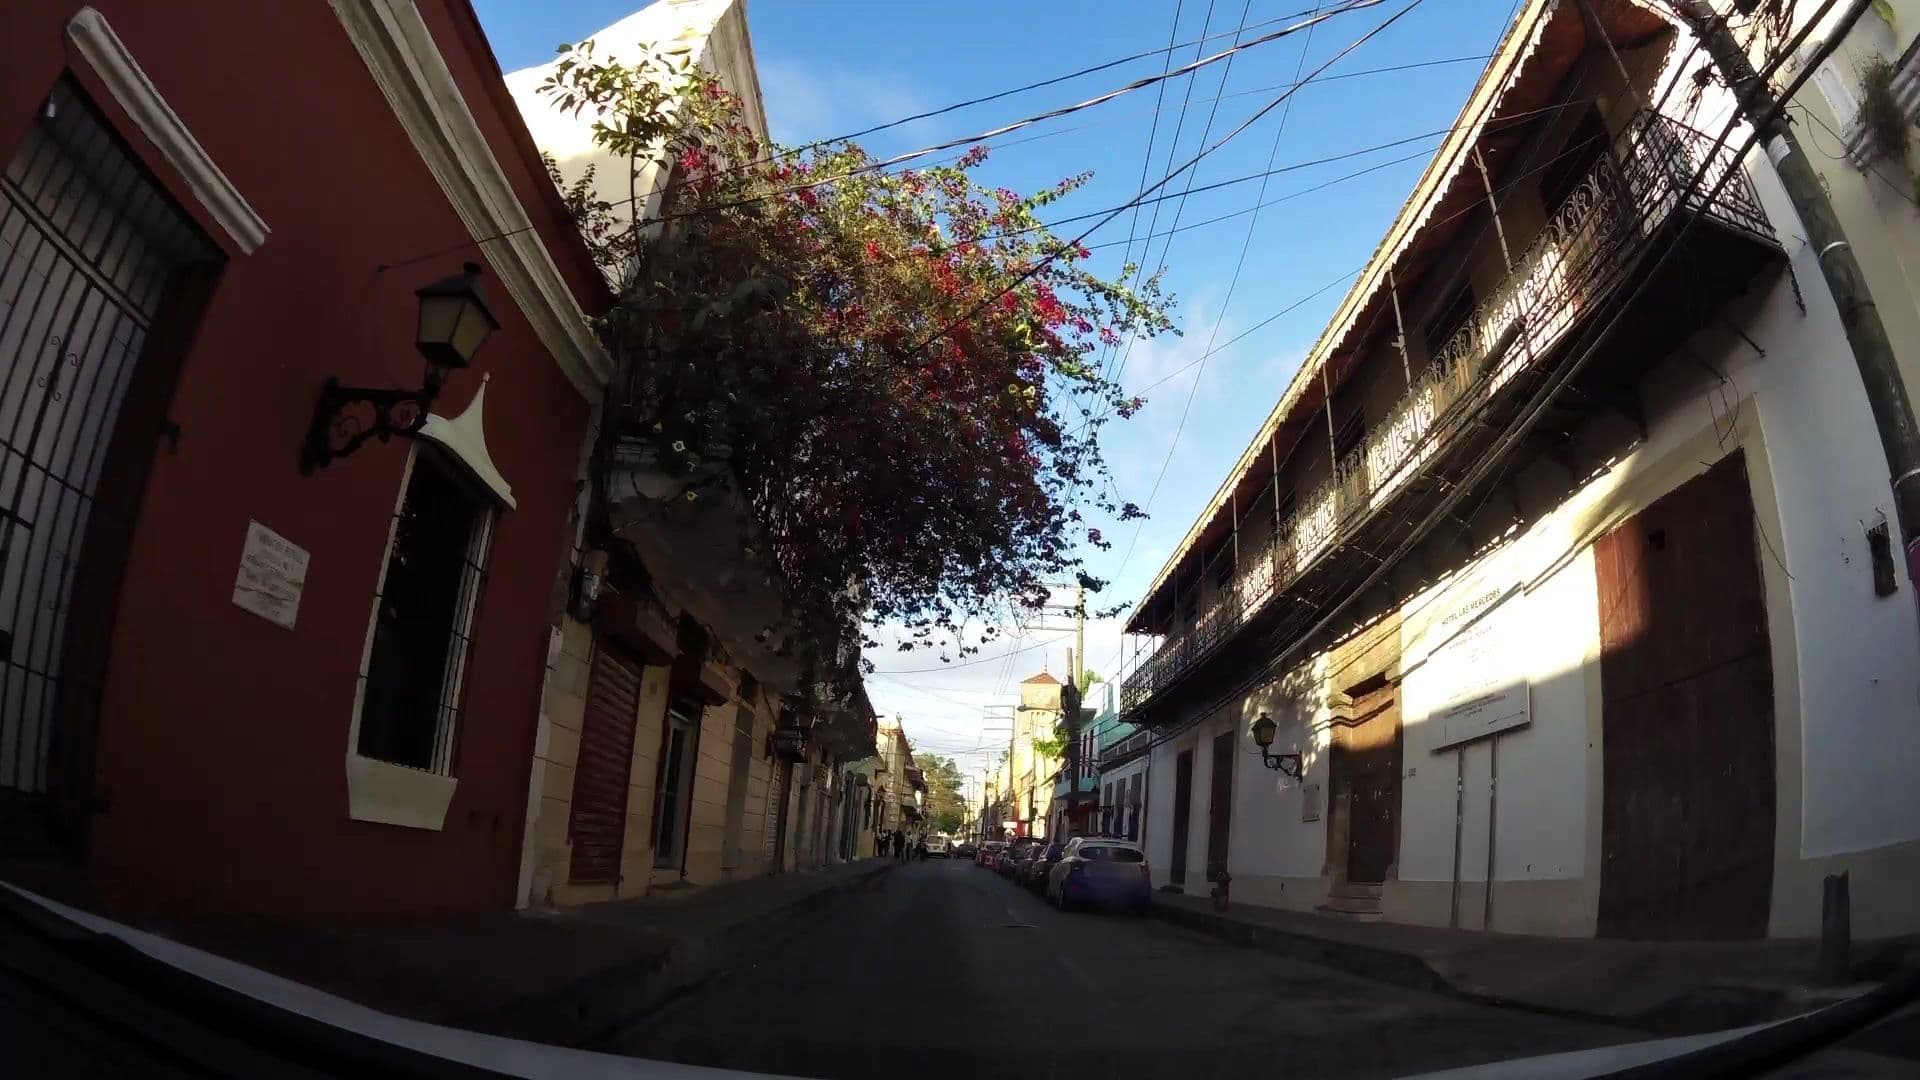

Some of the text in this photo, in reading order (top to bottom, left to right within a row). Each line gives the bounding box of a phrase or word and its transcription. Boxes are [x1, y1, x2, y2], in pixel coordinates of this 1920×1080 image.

[1442, 588, 1501, 625] HOTEL LAS MERCEDES
